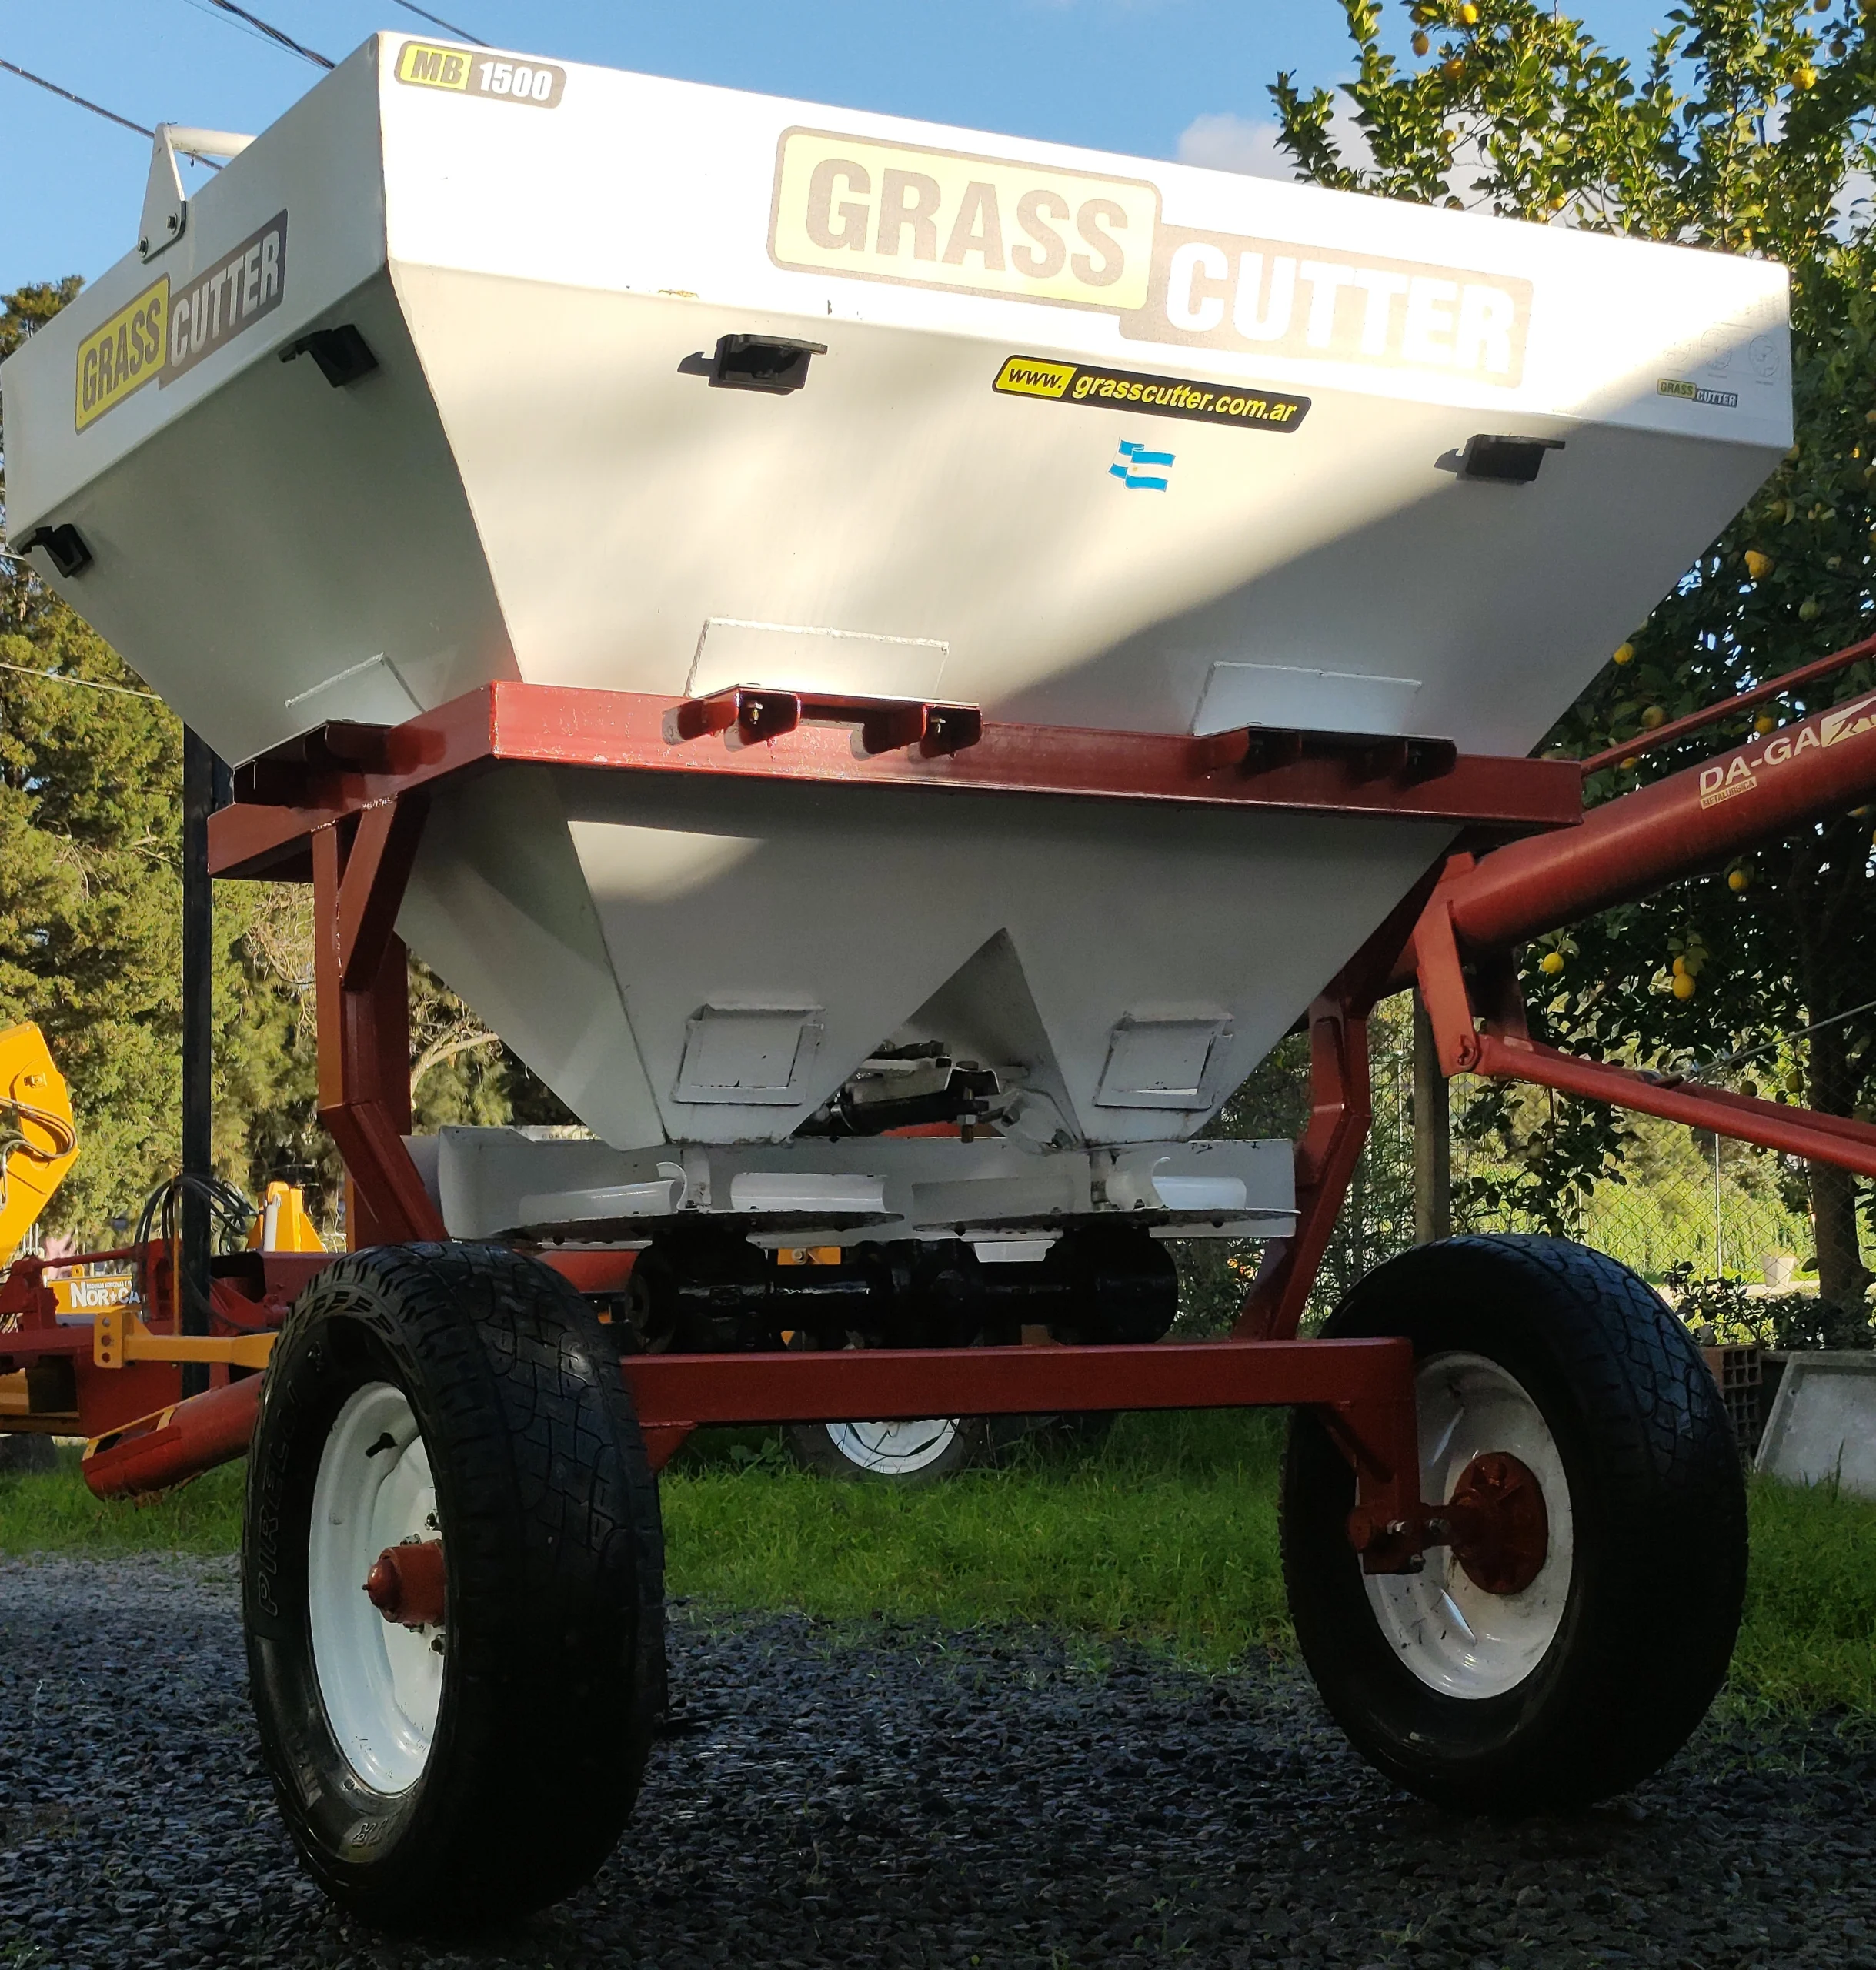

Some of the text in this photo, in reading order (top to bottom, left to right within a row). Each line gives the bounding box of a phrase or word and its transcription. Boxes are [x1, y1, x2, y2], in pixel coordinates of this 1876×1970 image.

[410, 49, 553, 101] MB 1500
[82, 229, 281, 412] GRASS CUTTER
[806, 158, 1515, 375] GRASS CUTTER
[1660, 381, 1736, 406] GRASS CUTTER
[1699, 726, 1821, 796] DA-GA
[259, 1379, 304, 1618] PIRELLI
